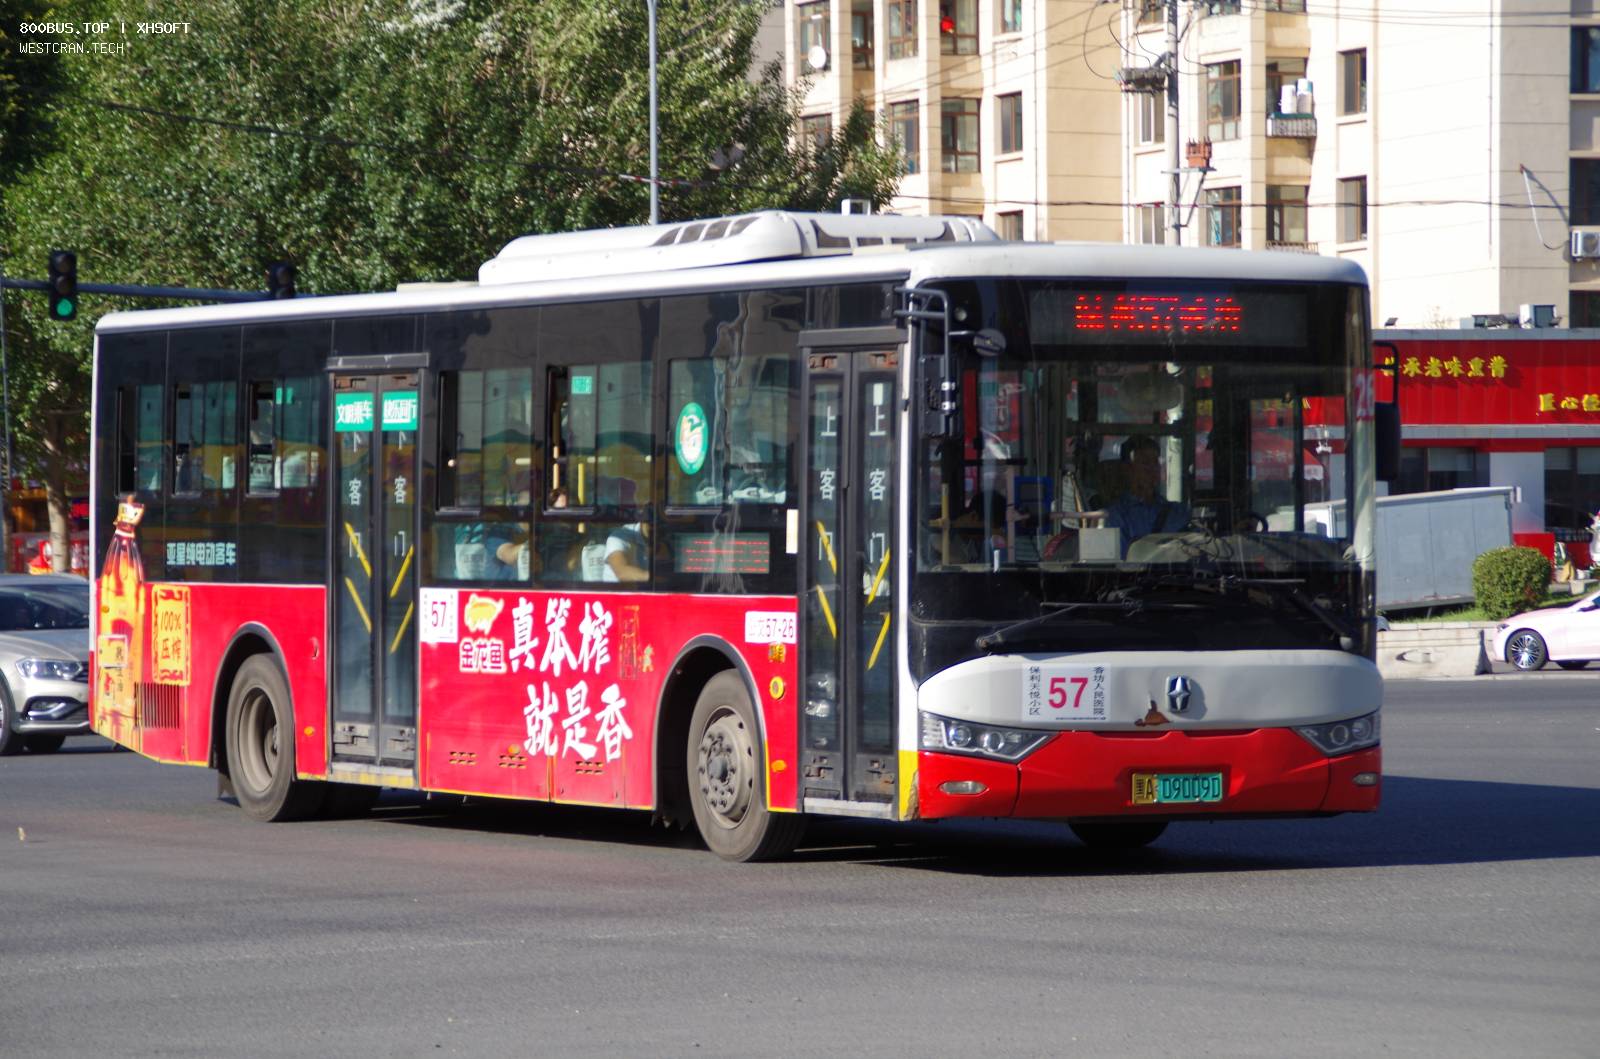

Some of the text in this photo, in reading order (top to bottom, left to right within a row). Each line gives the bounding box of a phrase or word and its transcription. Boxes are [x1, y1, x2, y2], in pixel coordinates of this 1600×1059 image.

[166, 542, 236, 566] 亚星纯电动客车
[160, 611, 182, 632] 100%
[432, 601, 446, 627] 57
[508, 596, 613, 678] 真笨榨
[460, 639, 504, 672] 金龙鱼
[1048, 677, 1088, 709] 57
[523, 679, 633, 763] 就是香
